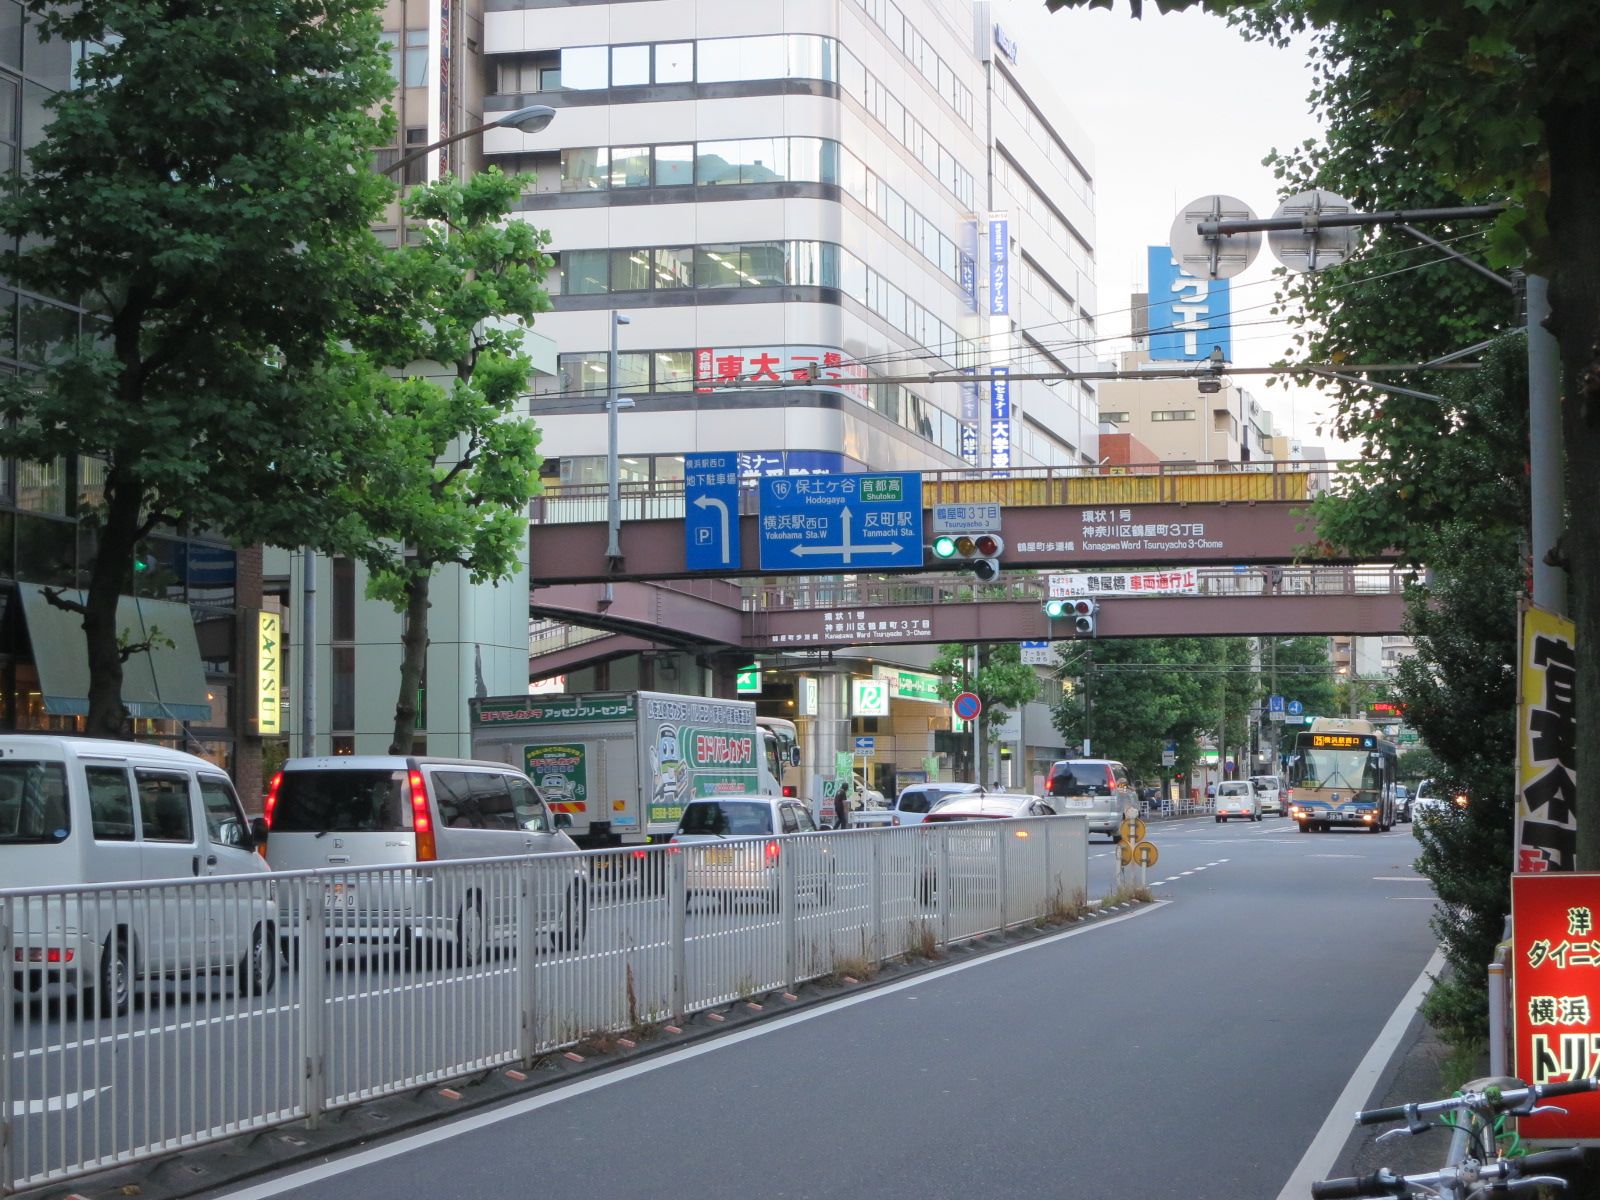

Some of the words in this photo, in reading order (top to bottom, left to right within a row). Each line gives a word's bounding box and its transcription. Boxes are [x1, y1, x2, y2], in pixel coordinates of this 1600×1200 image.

[686, 458, 725, 469] 横浜駅西口
[686, 473, 737, 487] 地下駐車場
[862, 480, 900, 493] 首都高
[775, 481, 787, 495] 16
[805, 495, 846, 505] Hodogaya
[866, 493, 896, 501] Shutoko
[864, 511, 913, 528] 反町駅
[937, 506, 997, 520] 鶴屋町3丁目
[1082, 509, 1132, 523] 環状1号
[763, 514, 829, 530] 横浜駅西口
[944, 520, 983, 529] Tsuruyacho
[765, 531, 803, 540] Yokohama
[862, 528, 898, 538] Tanmachi
[900, 527, 915, 537] Sta.
[1082, 523, 1204, 538] 神奈川区鶴屋町3丁目
[1082, 541, 1121, 551] Kanagawa
[1121, 540, 1141, 550] Ward
[1143, 540, 1187, 551] Tsuruyacho
[1188, 539, 1224, 549] 3-Chome
[1087, 575, 1126, 591] 鶴屋橋
[1129, 571, 1195, 591] 車両通行止
[824, 611, 865, 621] 環状1号
[825, 620, 930, 632] 神奈川区鶴屋町3丁目
[825, 633, 854, 641] Kanagawa
[873, 630, 903, 639] Tsuruyacho
[906, 629, 932, 637] 3-Chome
[262, 617, 277, 727] SANSUI
[697, 735, 752, 764] ヨドバシカメラ
[1567, 907, 1592, 935] 洋
[1529, 995, 1591, 1026] 横浜
